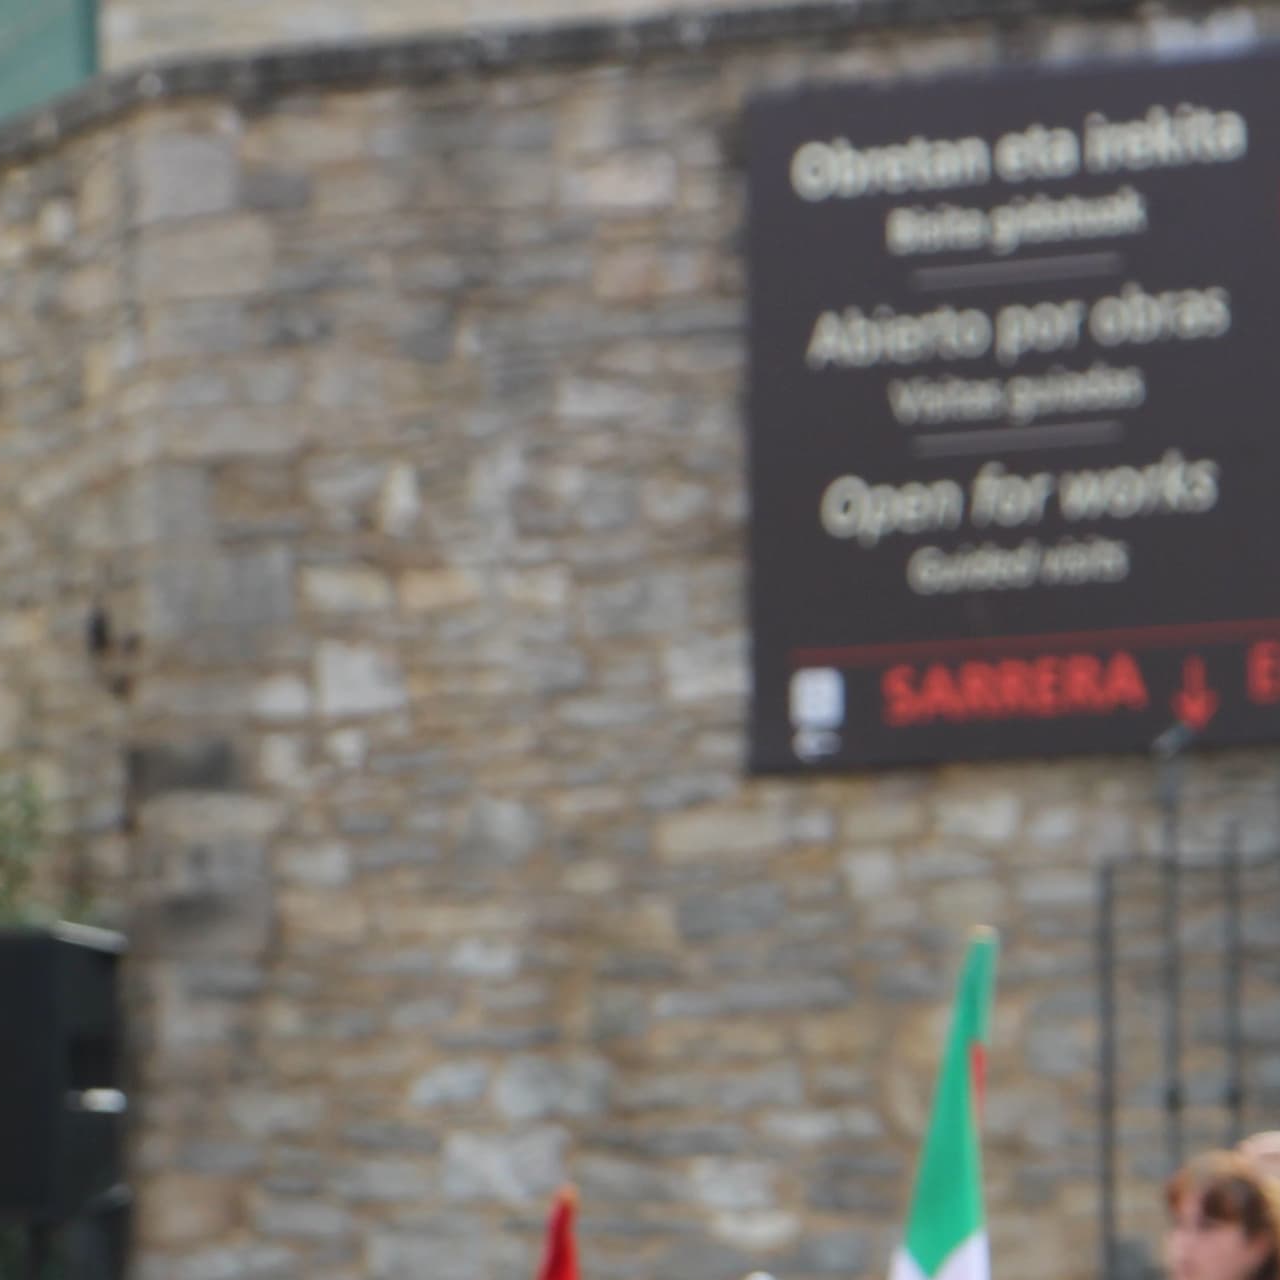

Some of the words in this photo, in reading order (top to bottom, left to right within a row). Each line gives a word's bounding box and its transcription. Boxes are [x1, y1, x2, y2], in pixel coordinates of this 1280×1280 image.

[996, 300, 1086, 366] por
[1089, 282, 1231, 346] obras
[820, 474, 964, 547] Open
[970, 460, 1054, 527] for
[1058, 447, 1219, 521] works
[882, 654, 1150, 728] SARRERA
